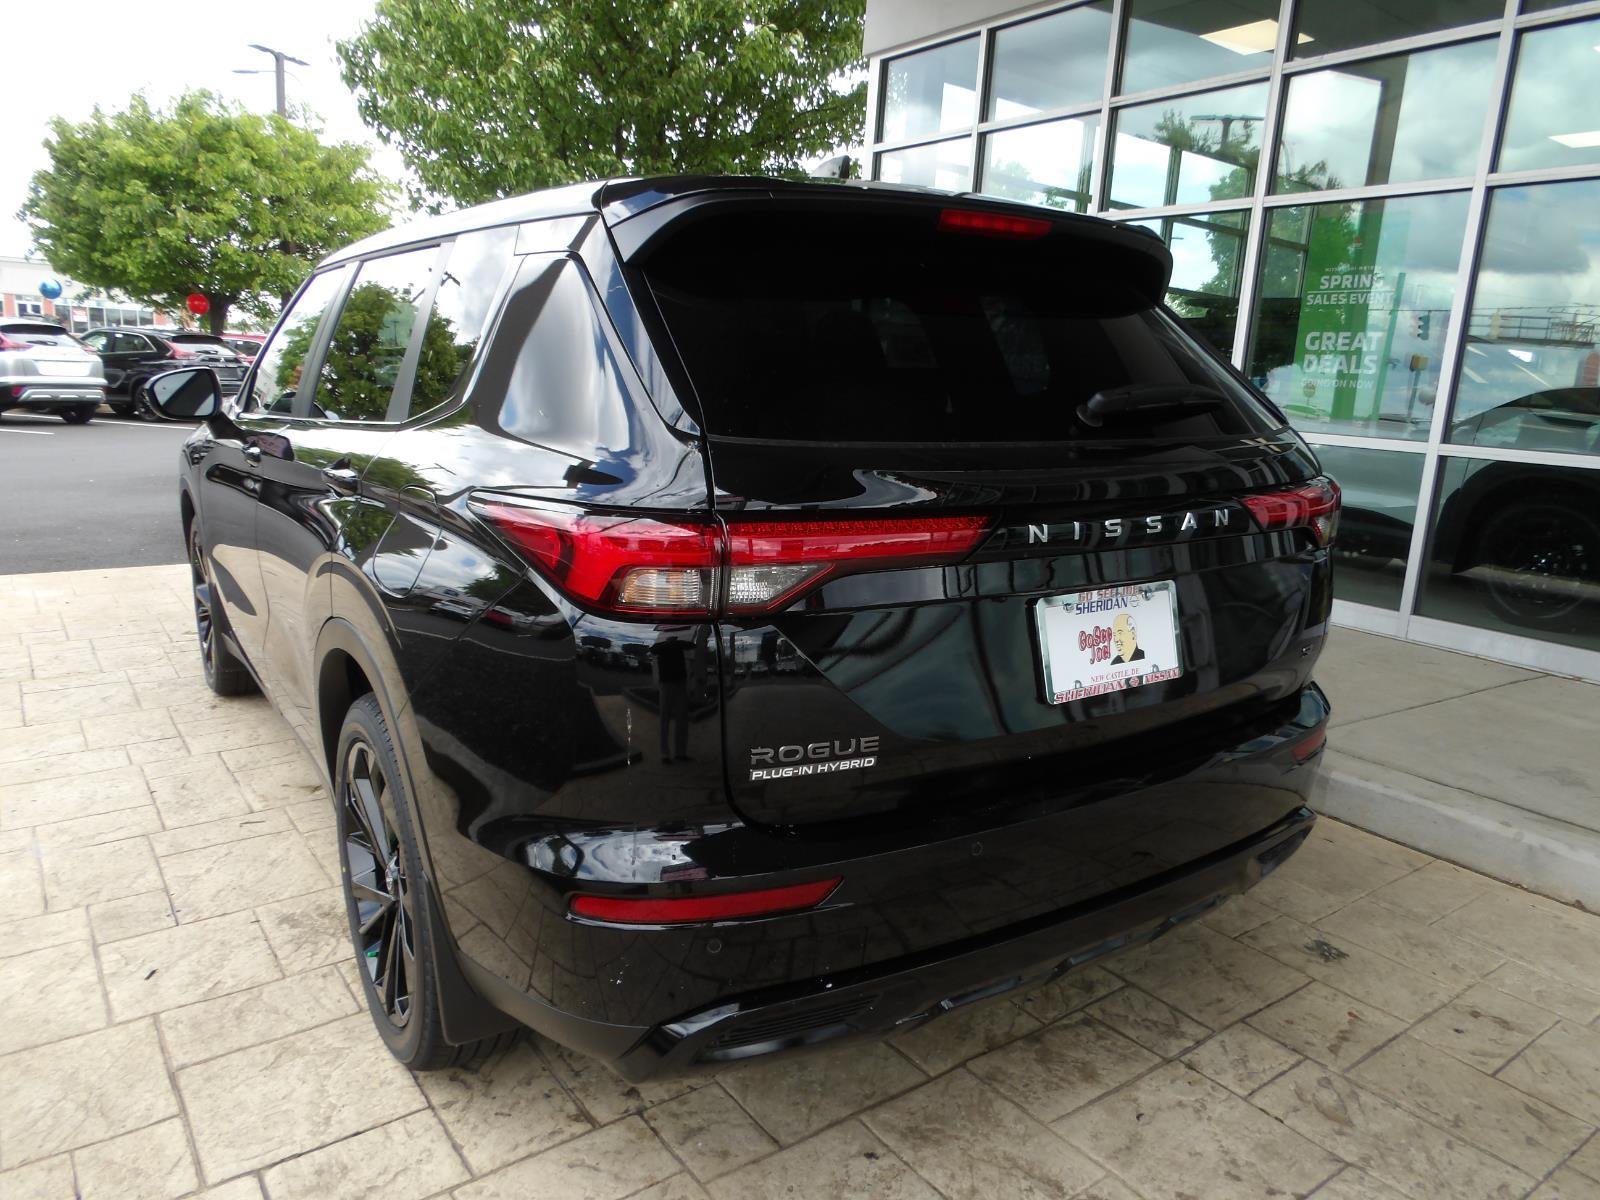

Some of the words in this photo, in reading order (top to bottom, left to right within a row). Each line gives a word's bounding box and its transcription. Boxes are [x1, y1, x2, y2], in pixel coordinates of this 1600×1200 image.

[1320, 274, 1384, 290] SPRING
[1306, 293, 1346, 305] SALES
[1349, 292, 1394, 305] EVENT
[1305, 331, 1384, 352] GREAT
[1303, 354, 1378, 375] DEALS
[1332, 379, 1347, 388] ON
[1348, 379, 1375, 389] NOW
[1028, 508, 1230, 544] NISSAN
[1075, 596, 1129, 616] SHERIDAN
[1091, 674, 1105, 683] NEW
[1131, 668, 1140, 676] DE
[1145, 668, 1180, 685] NISSAN
[750, 735, 880, 765] ROGUE
[751, 764, 813, 781] PLUG-IN
[817, 757, 875, 774] HYBRID
